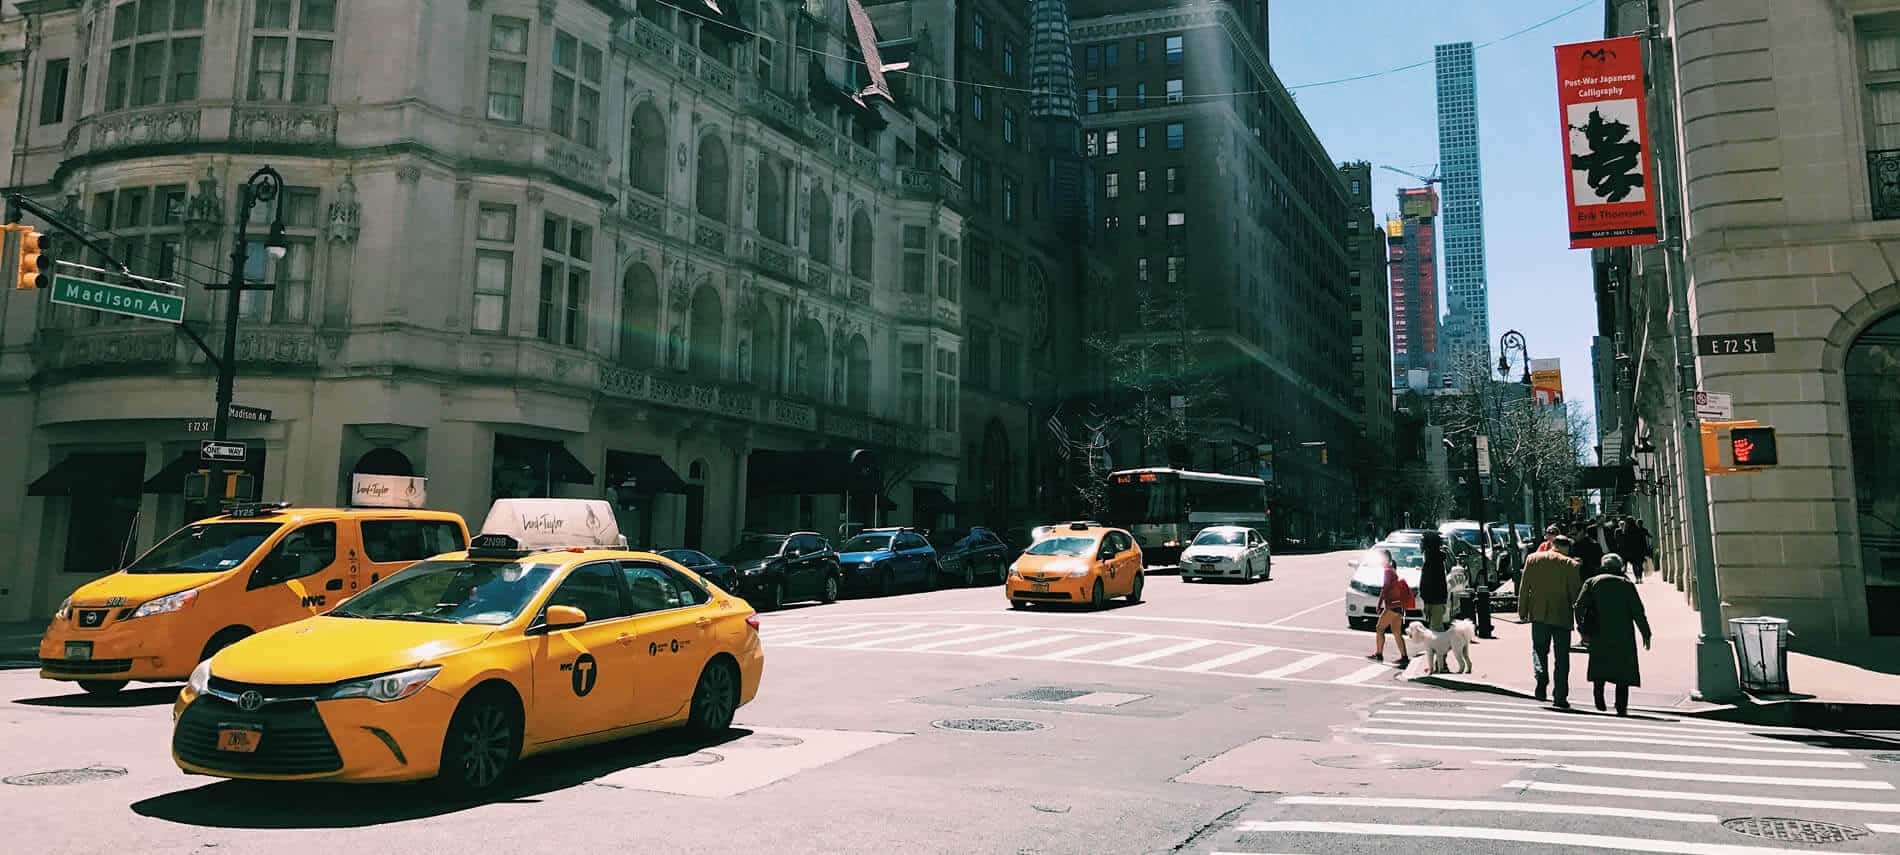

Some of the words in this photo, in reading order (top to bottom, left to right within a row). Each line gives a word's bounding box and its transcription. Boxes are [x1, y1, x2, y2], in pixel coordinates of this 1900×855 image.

[1564, 76, 1598, 88] Post-War
[1600, 74, 1636, 84] Japanese
[1578, 87, 1624, 97] Calligraphy
[66, 283, 143, 310] Madison
[147, 299, 171, 314] Av
[1712, 340, 1719, 354] E
[1723, 339, 1739, 353] 72
[1743, 338, 1758, 352] St
[229, 407, 257, 420] Madison
[258, 413, 268, 421] Av
[188, 422, 193, 432] E
[193, 422, 201, 432] 72
[201, 421, 209, 432] St
[206, 446, 219, 455] ONE
[228, 447, 242, 455] WAY
[482, 536, 507, 546] 2N98
[302, 594, 326, 608] NYC
[560, 663, 573, 671] NYC
